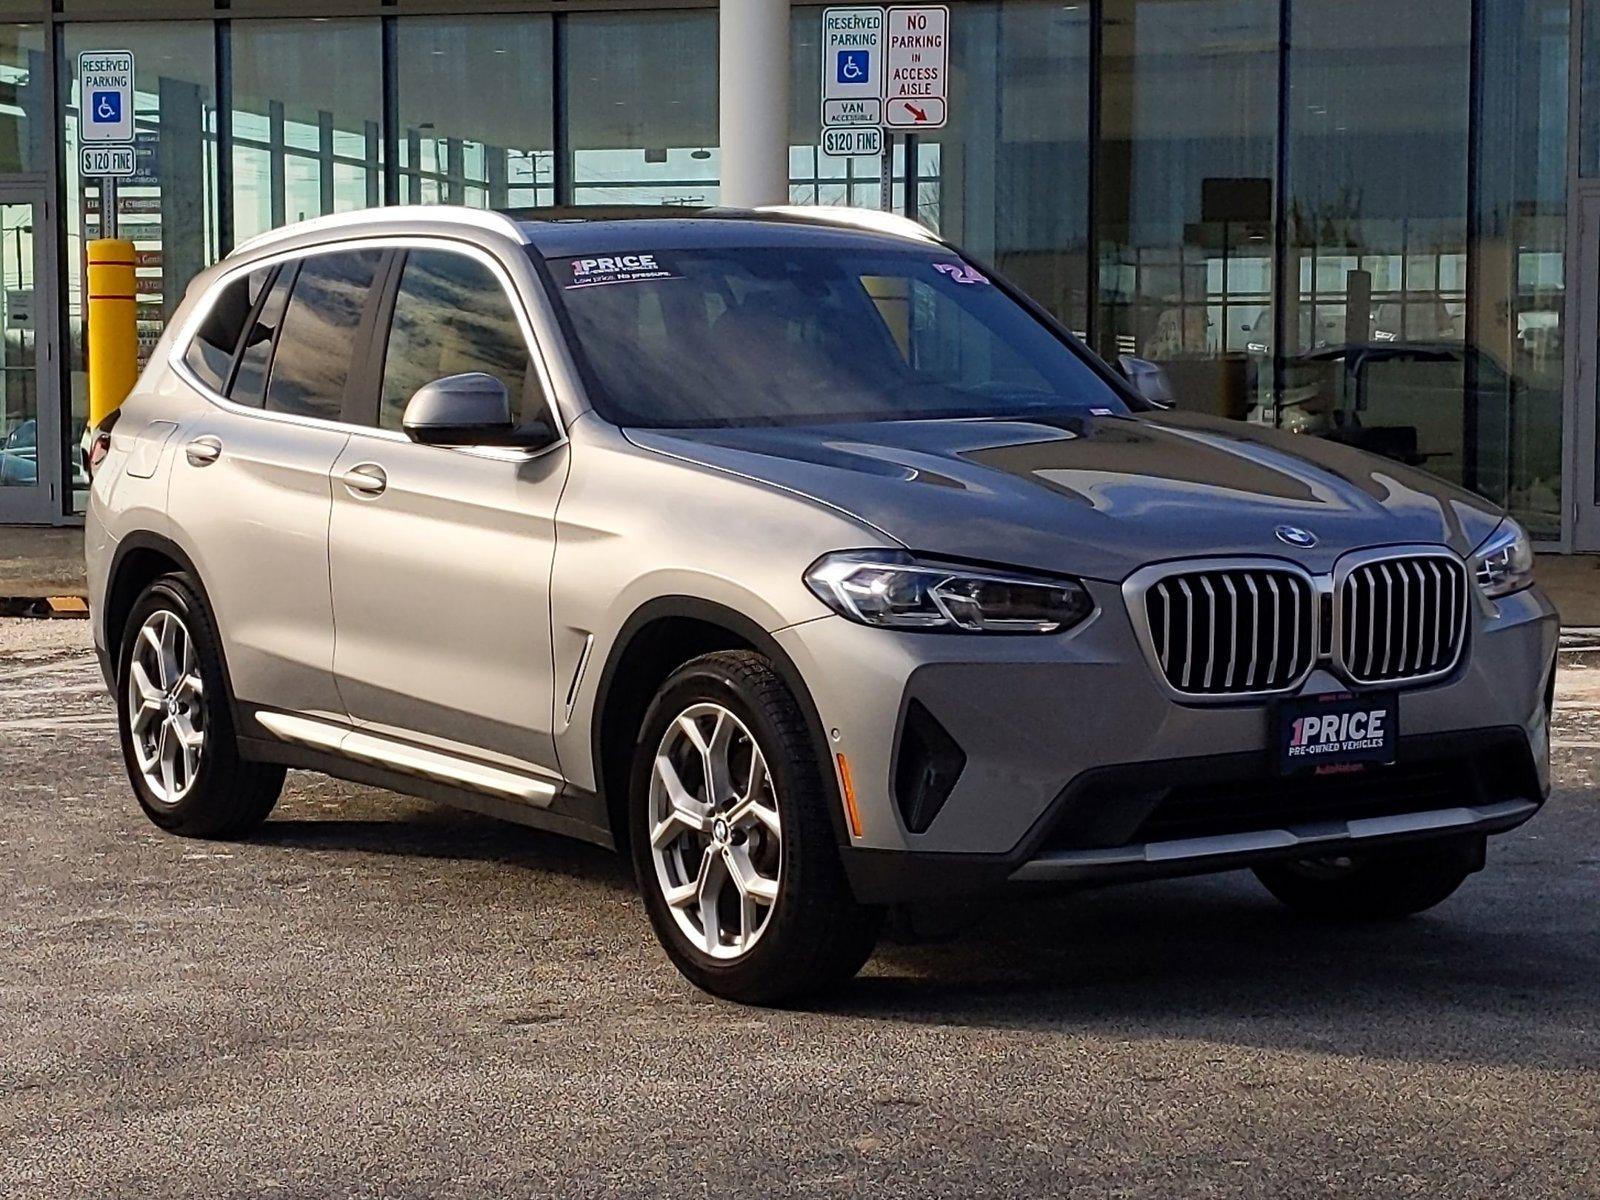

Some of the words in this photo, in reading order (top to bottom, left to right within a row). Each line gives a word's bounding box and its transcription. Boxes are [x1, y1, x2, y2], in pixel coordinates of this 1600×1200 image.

[827, 17, 880, 29] RESERVED
[907, 15, 927, 30] NO
[830, 33, 877, 46] PARKING
[891, 35, 942, 48] PARKING
[911, 54, 921, 62] IN
[82, 61, 130, 71] RESERVED
[893, 68, 938, 80] ACCESS
[86, 76, 127, 87] PARKING
[899, 83, 932, 95] AISLE
[841, 103, 864, 113] VAN
[856, 133, 878, 150] FINE
[112, 153, 131, 170] FINE
[1288, 743, 1340, 756] PRE-OWNED
[1342, 738, 1384, 750] VEHICLES
